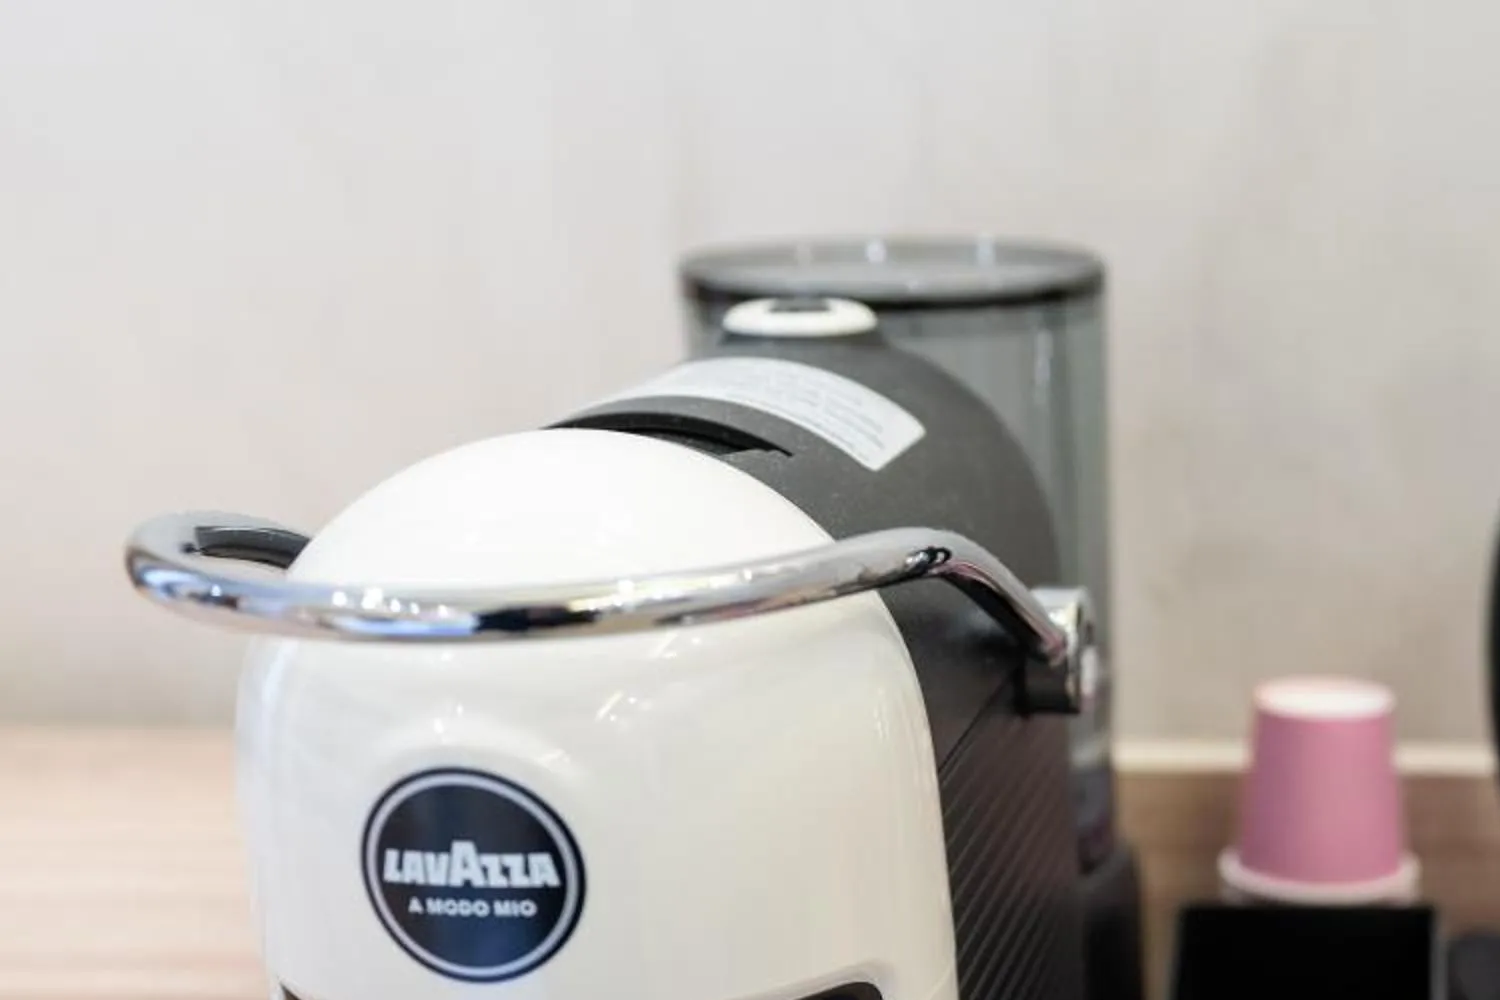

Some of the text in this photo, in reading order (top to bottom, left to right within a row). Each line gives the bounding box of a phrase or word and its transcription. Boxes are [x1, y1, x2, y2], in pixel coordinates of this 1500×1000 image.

[383, 840, 560, 888] LAVAZZA
[408, 896, 538, 917] A MODO MIO
